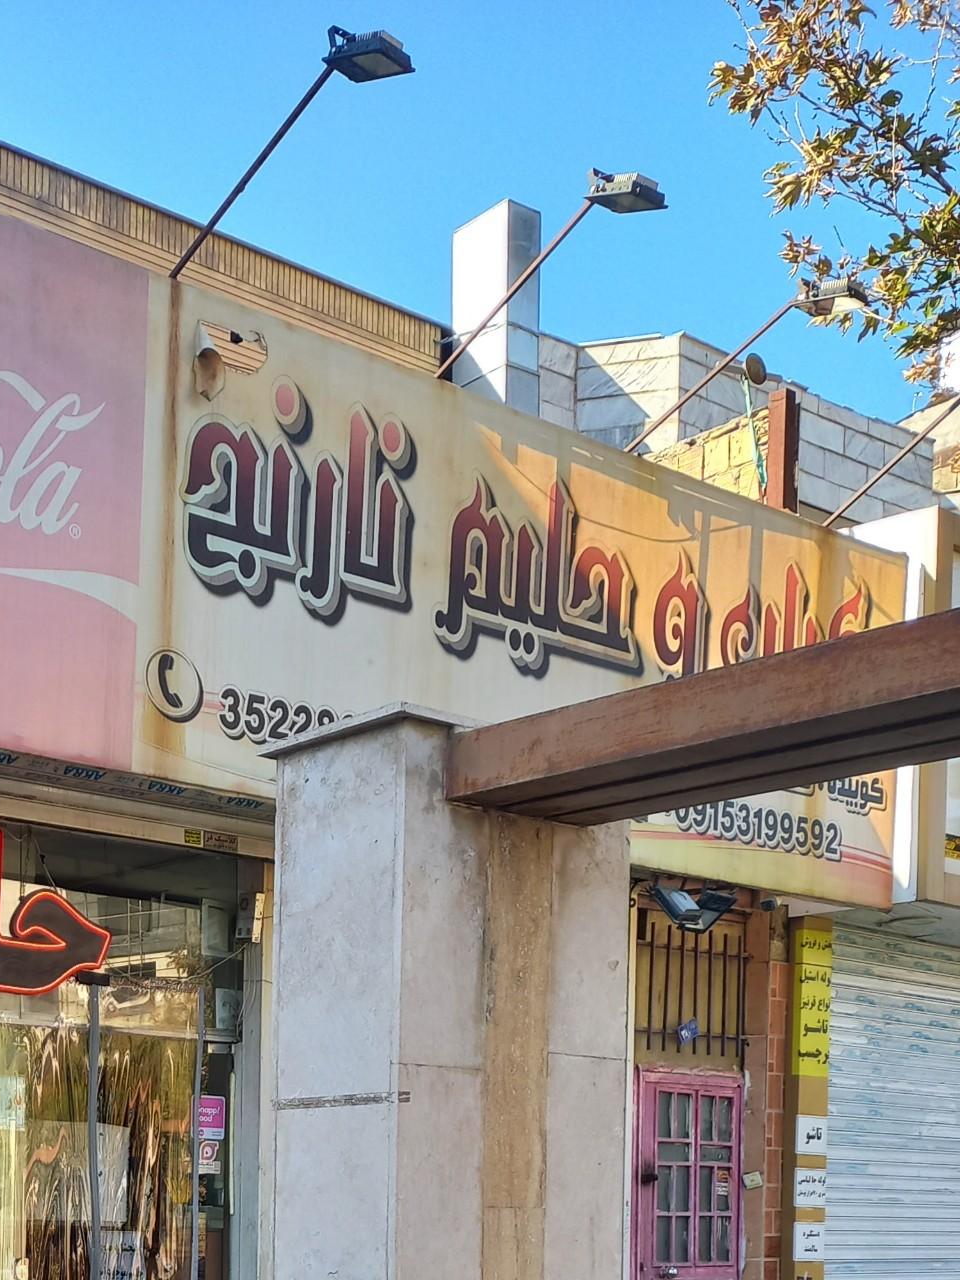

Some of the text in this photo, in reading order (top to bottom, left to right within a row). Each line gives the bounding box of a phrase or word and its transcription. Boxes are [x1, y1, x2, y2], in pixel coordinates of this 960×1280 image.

[183, 376, 408, 610] نارنج
[436, 474, 639, 670] حلیم
[219, 687, 354, 741] 3522
[674, 801, 839, 856] 09153199592
[198, 1114, 213, 1123] ood
